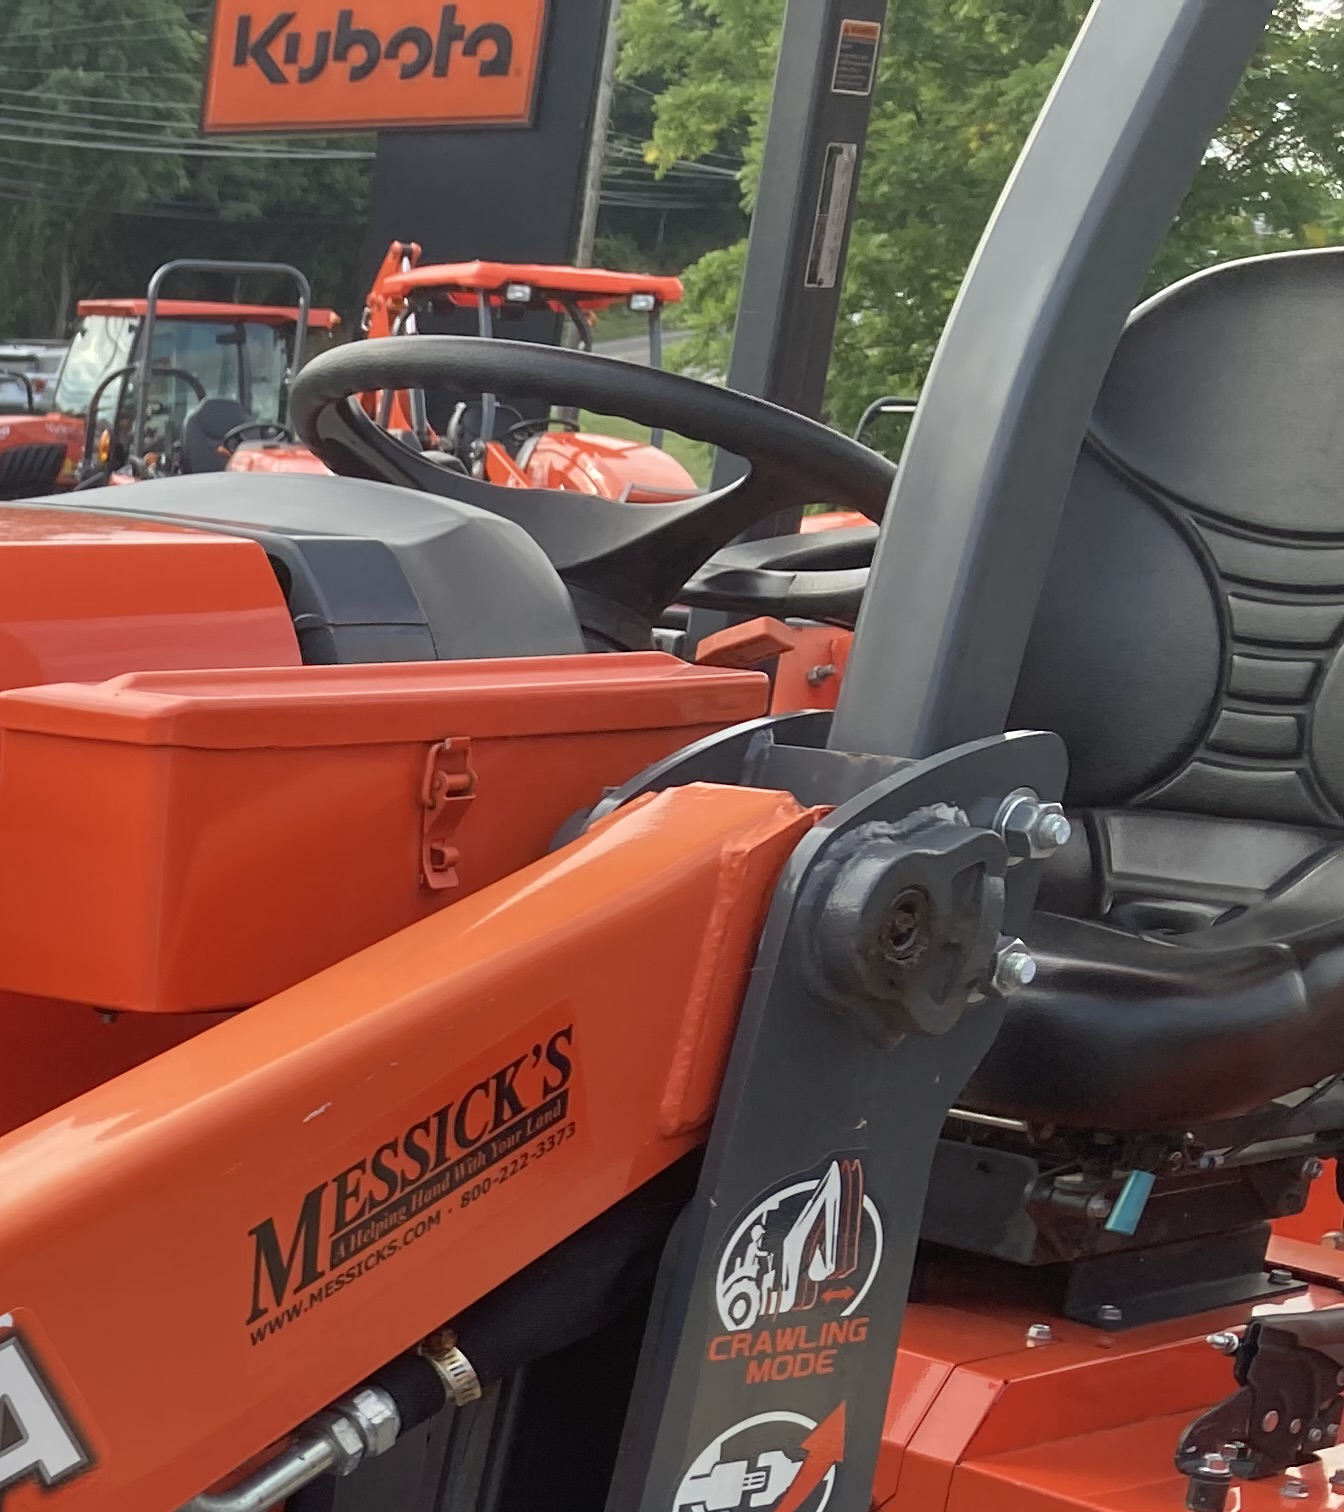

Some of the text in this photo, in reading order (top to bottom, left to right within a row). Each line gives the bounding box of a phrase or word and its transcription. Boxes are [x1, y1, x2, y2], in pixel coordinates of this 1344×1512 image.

[233, 4, 513, 84] Kubota
[246, 1024, 573, 1325] MESSICK'S
[249, 1121, 577, 1346] WWW.MESSICKS.COM 800-222-3373
[333, 1100, 562, 1264] A Helping Hand With Your Land
[709, 1317, 869, 1361] CRAWLING
[746, 1349, 838, 1384] MODE
